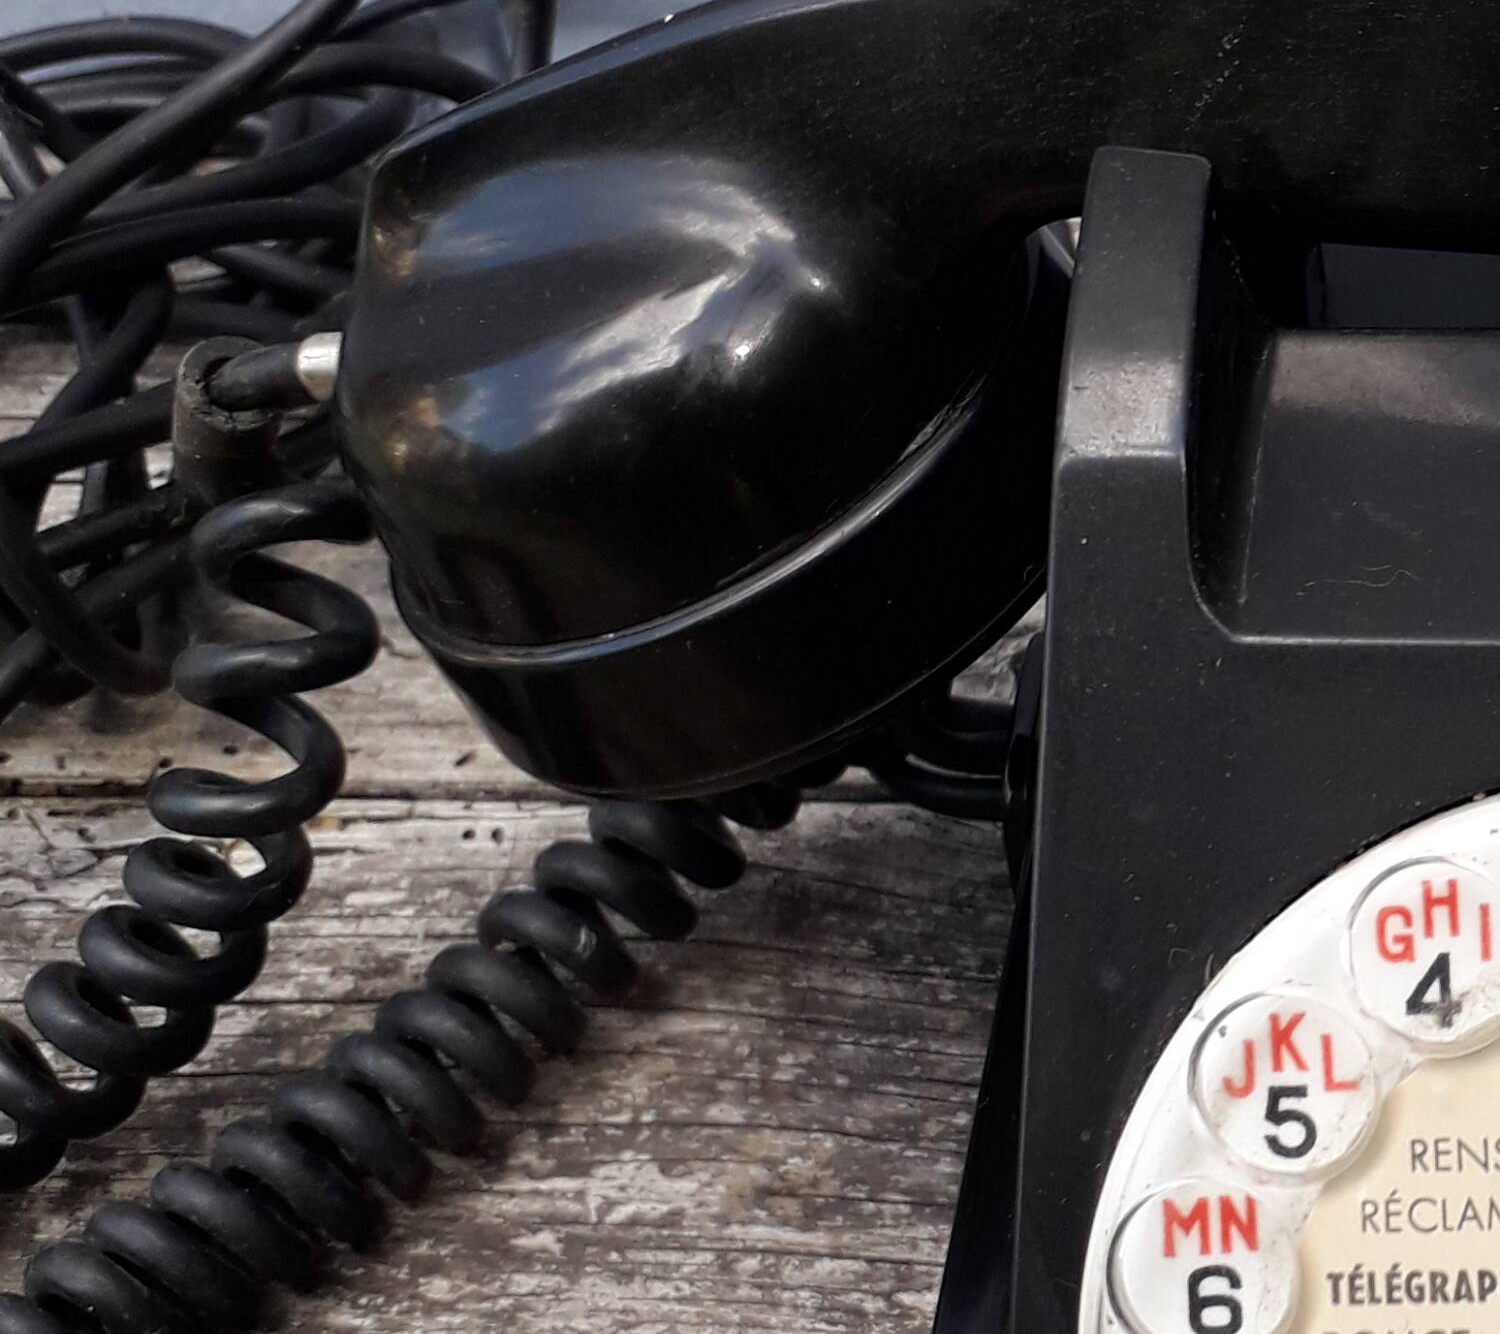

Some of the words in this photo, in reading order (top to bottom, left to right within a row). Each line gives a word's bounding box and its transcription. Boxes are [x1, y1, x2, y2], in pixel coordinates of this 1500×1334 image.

[1375, 879, 1492, 964] GHI
[1406, 953, 1461, 1028] 4
[1223, 1013, 1357, 1100] JKL
[1265, 1086, 1316, 1158] 5
[1162, 1195, 1259, 1259] MN
